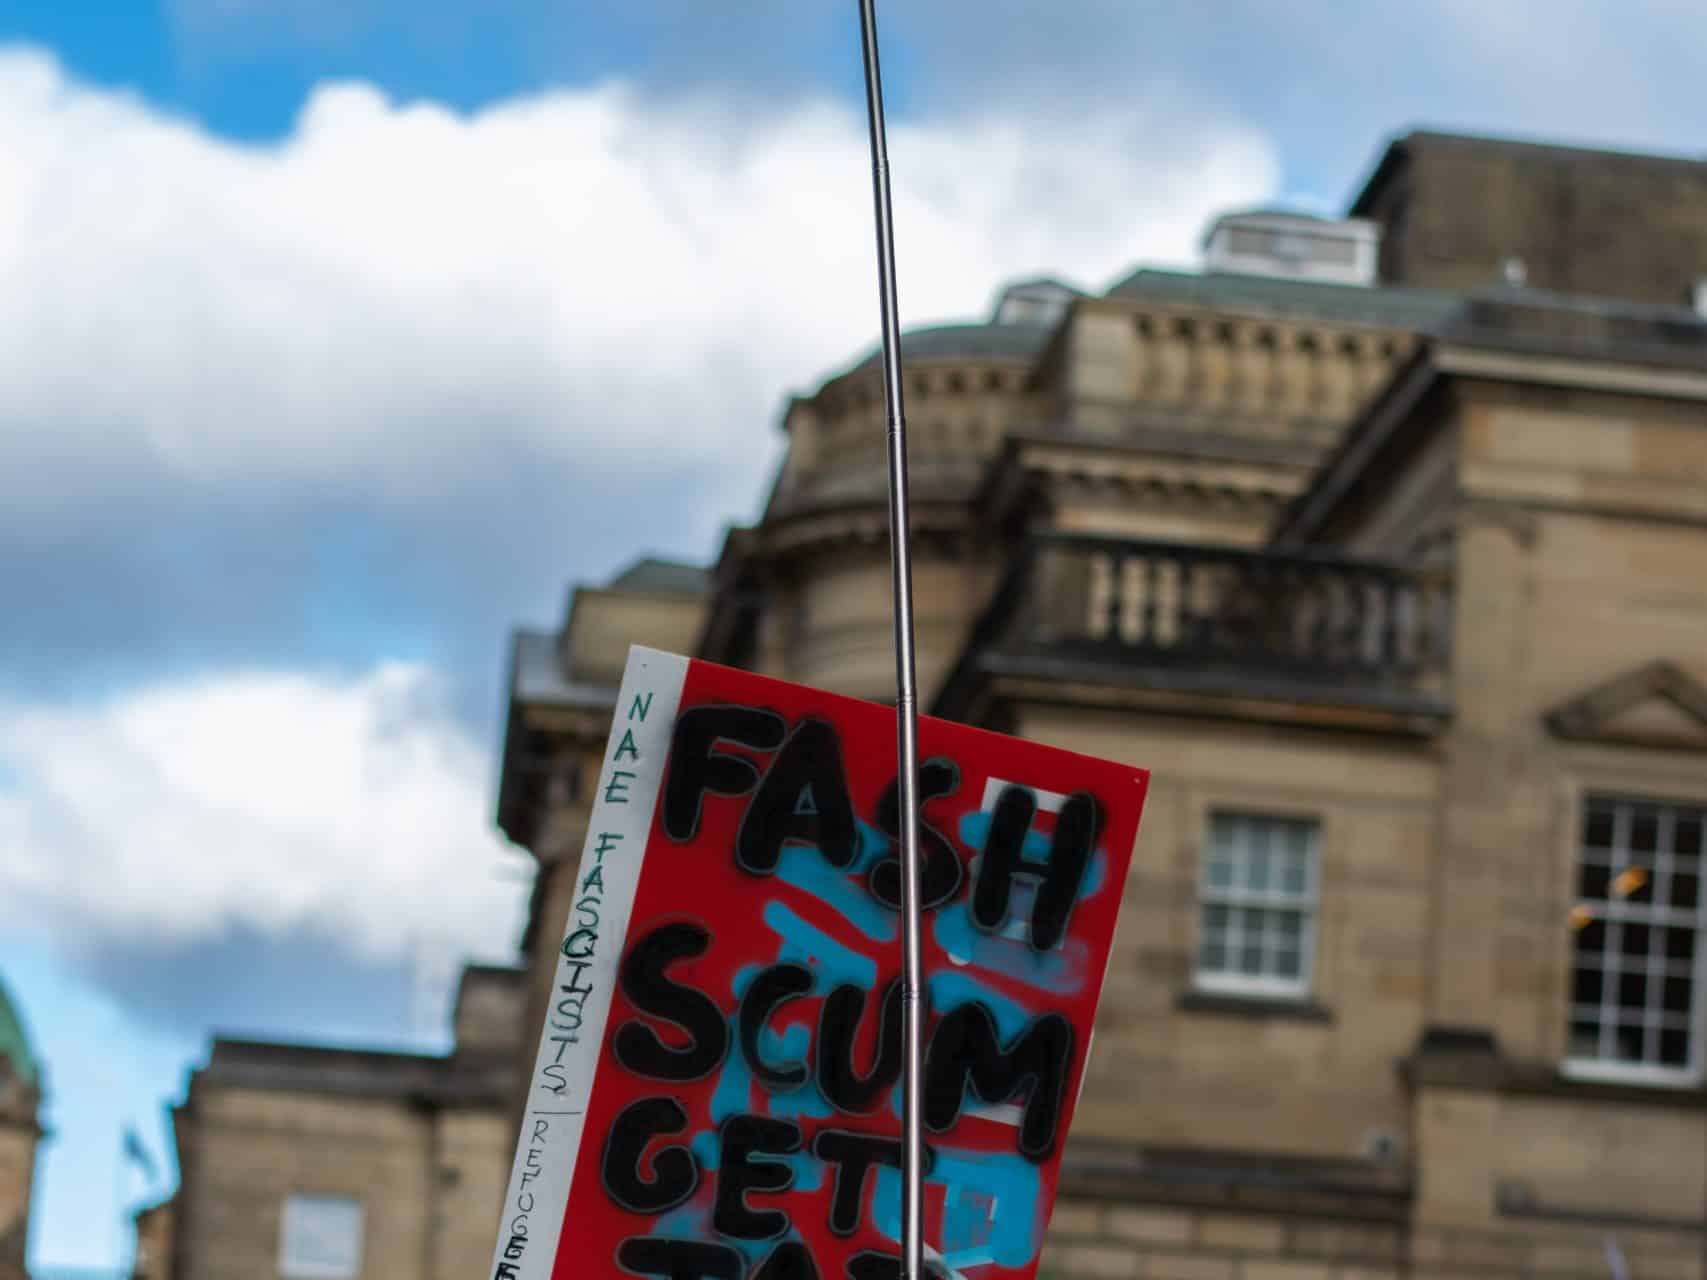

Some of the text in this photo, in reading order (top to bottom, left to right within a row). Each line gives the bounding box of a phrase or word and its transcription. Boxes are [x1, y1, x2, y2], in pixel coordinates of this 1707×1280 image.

[604, 692, 653, 803] NAE
[661, 704, 1098, 952] FASH
[611, 921, 1075, 1162] SCUM
[602, 1096, 935, 1240] GET
